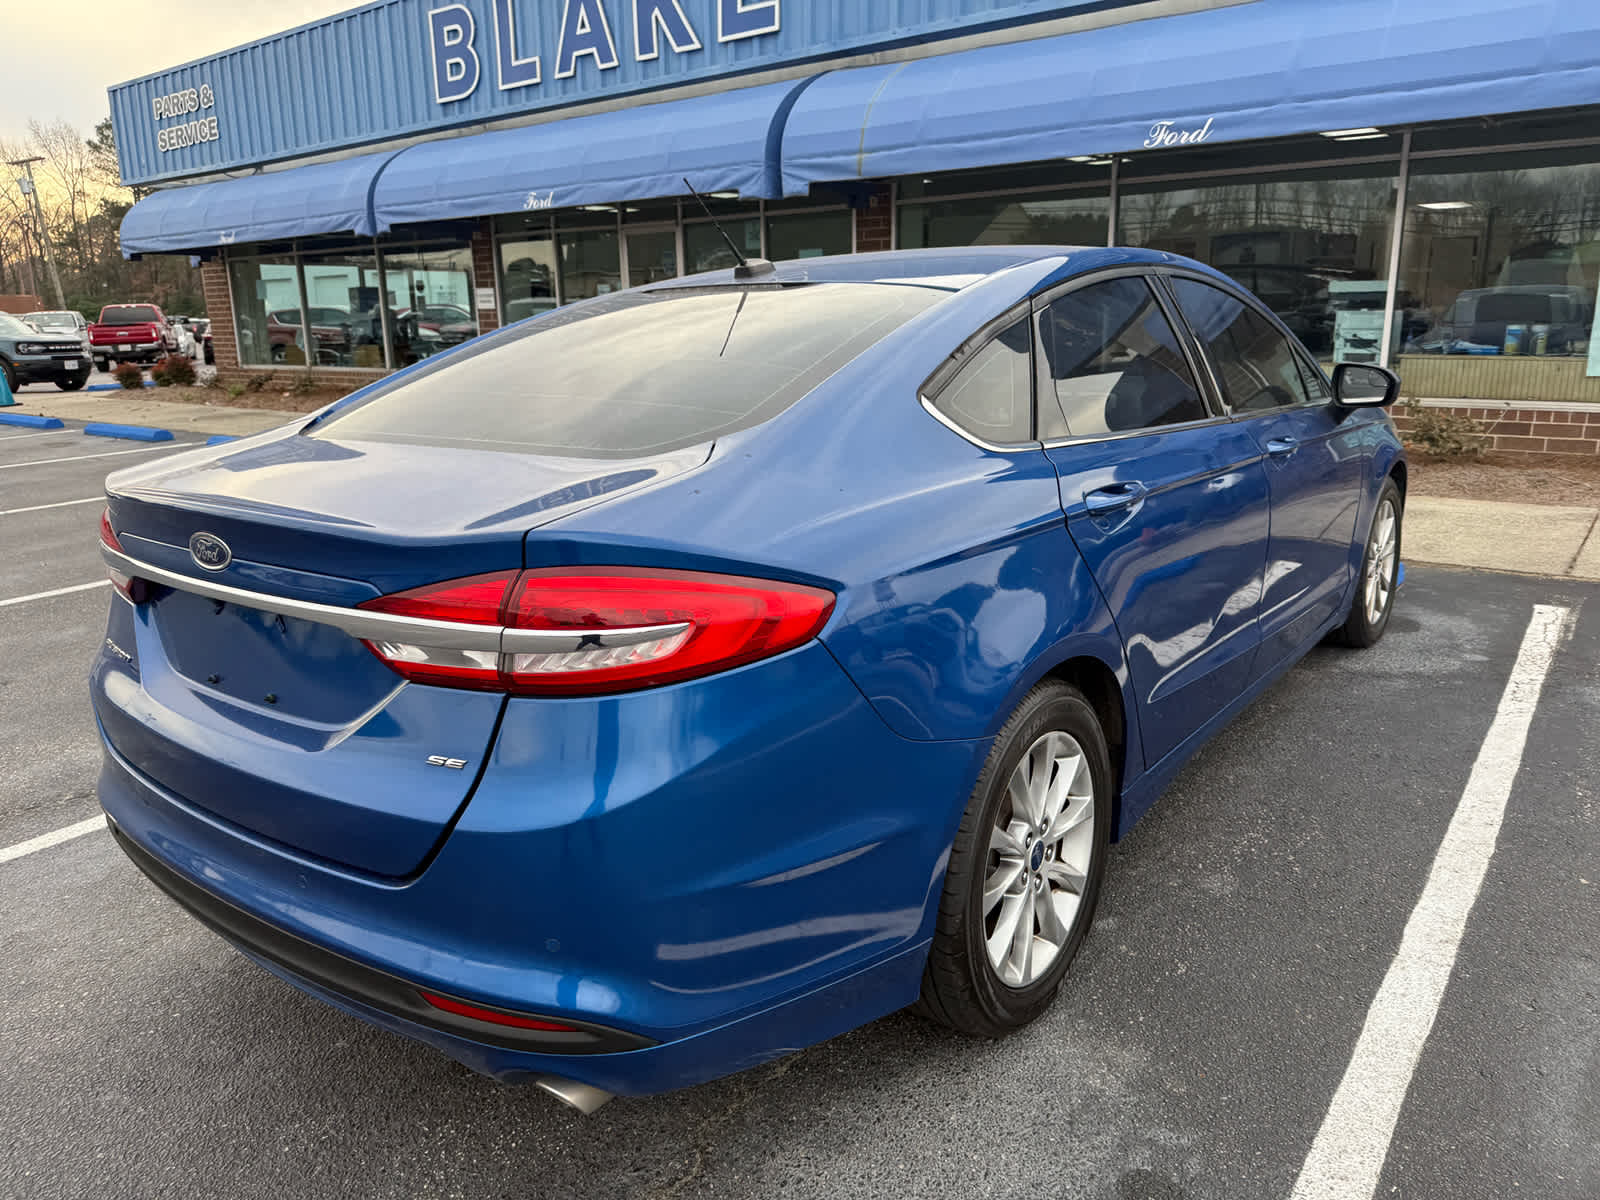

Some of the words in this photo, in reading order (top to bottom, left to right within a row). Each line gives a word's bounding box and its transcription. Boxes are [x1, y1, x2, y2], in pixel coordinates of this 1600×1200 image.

[152, 88, 199, 120] PARTS
[200, 84, 214, 109] &
[158, 116, 219, 152] SERVICE
[1143, 117, 1215, 149] Ford
[523, 191, 554, 209] Ford
[195, 538, 221, 563] Ford
[425, 755, 468, 769] SE
